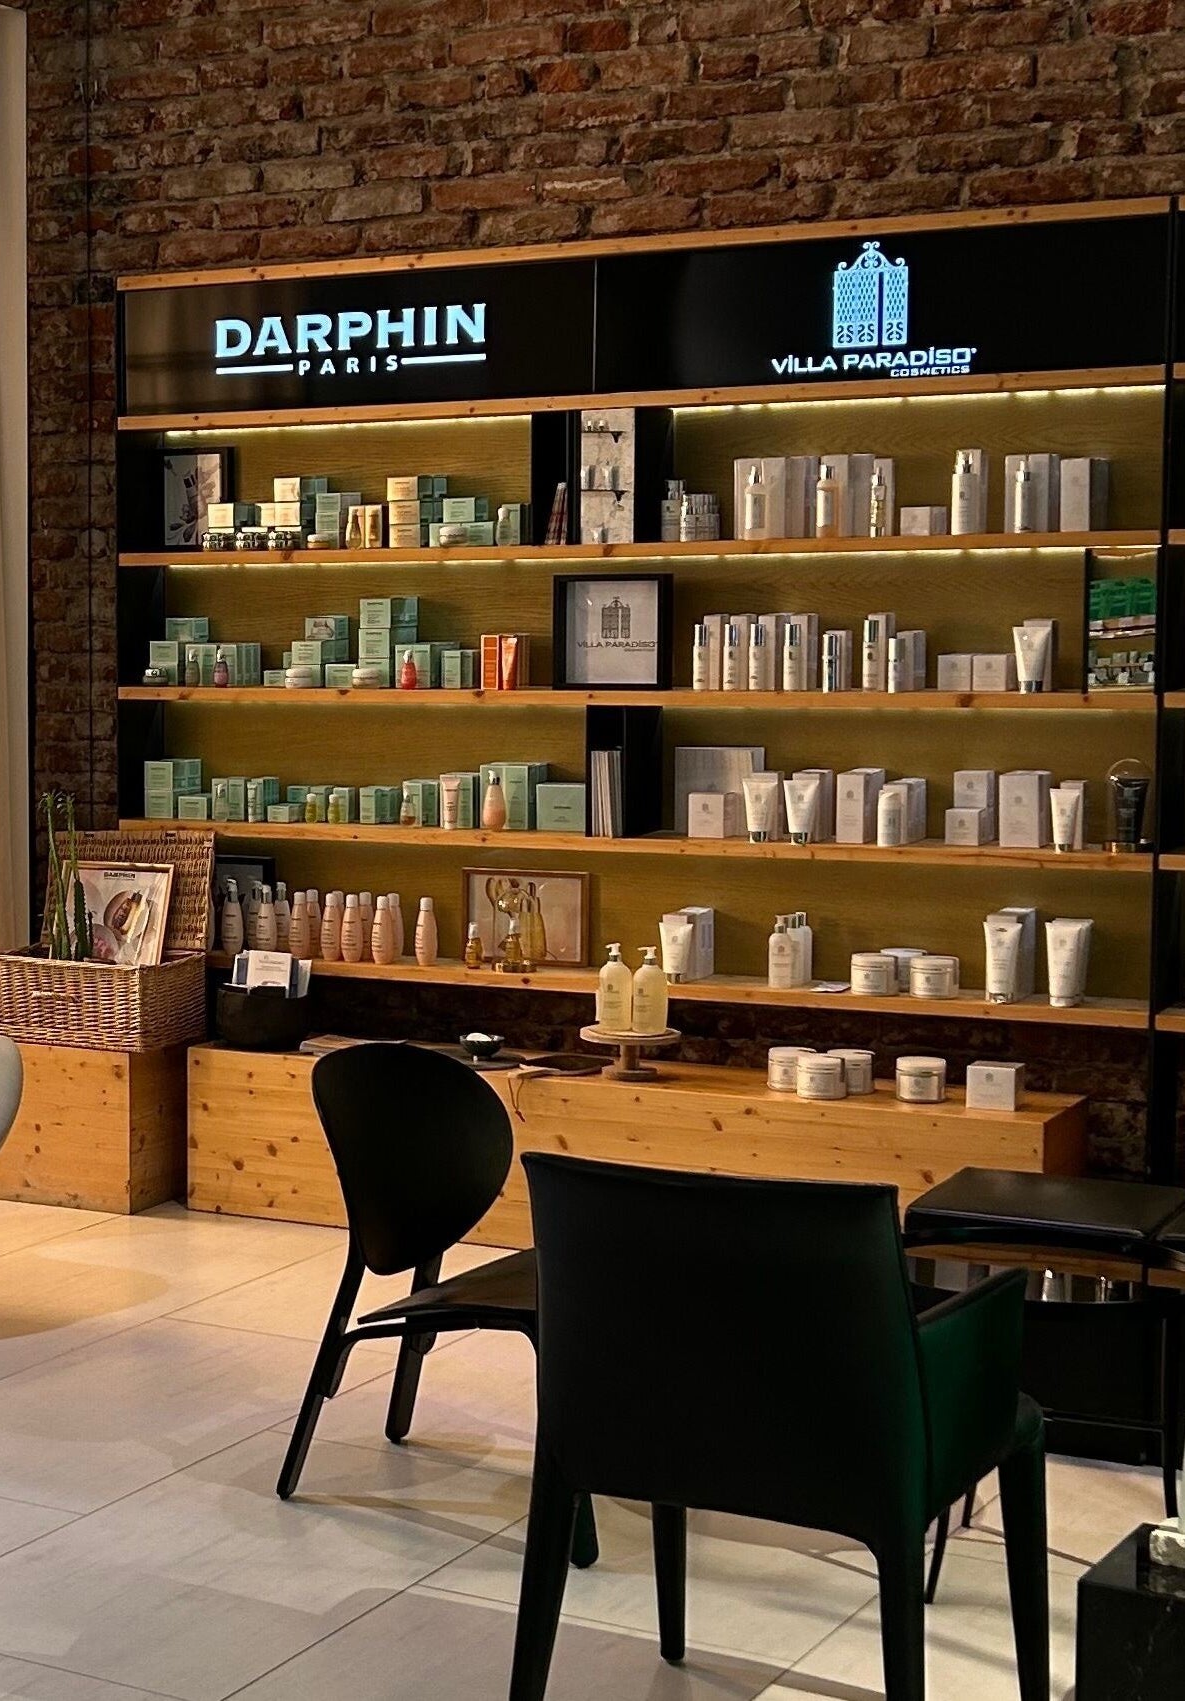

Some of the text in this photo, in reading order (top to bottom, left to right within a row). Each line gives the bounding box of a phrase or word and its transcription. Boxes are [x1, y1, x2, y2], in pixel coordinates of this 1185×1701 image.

[215, 303, 486, 358] DARPHIN
[298, 355, 399, 376] PARIS
[890, 364, 971, 378] COSMETICS
